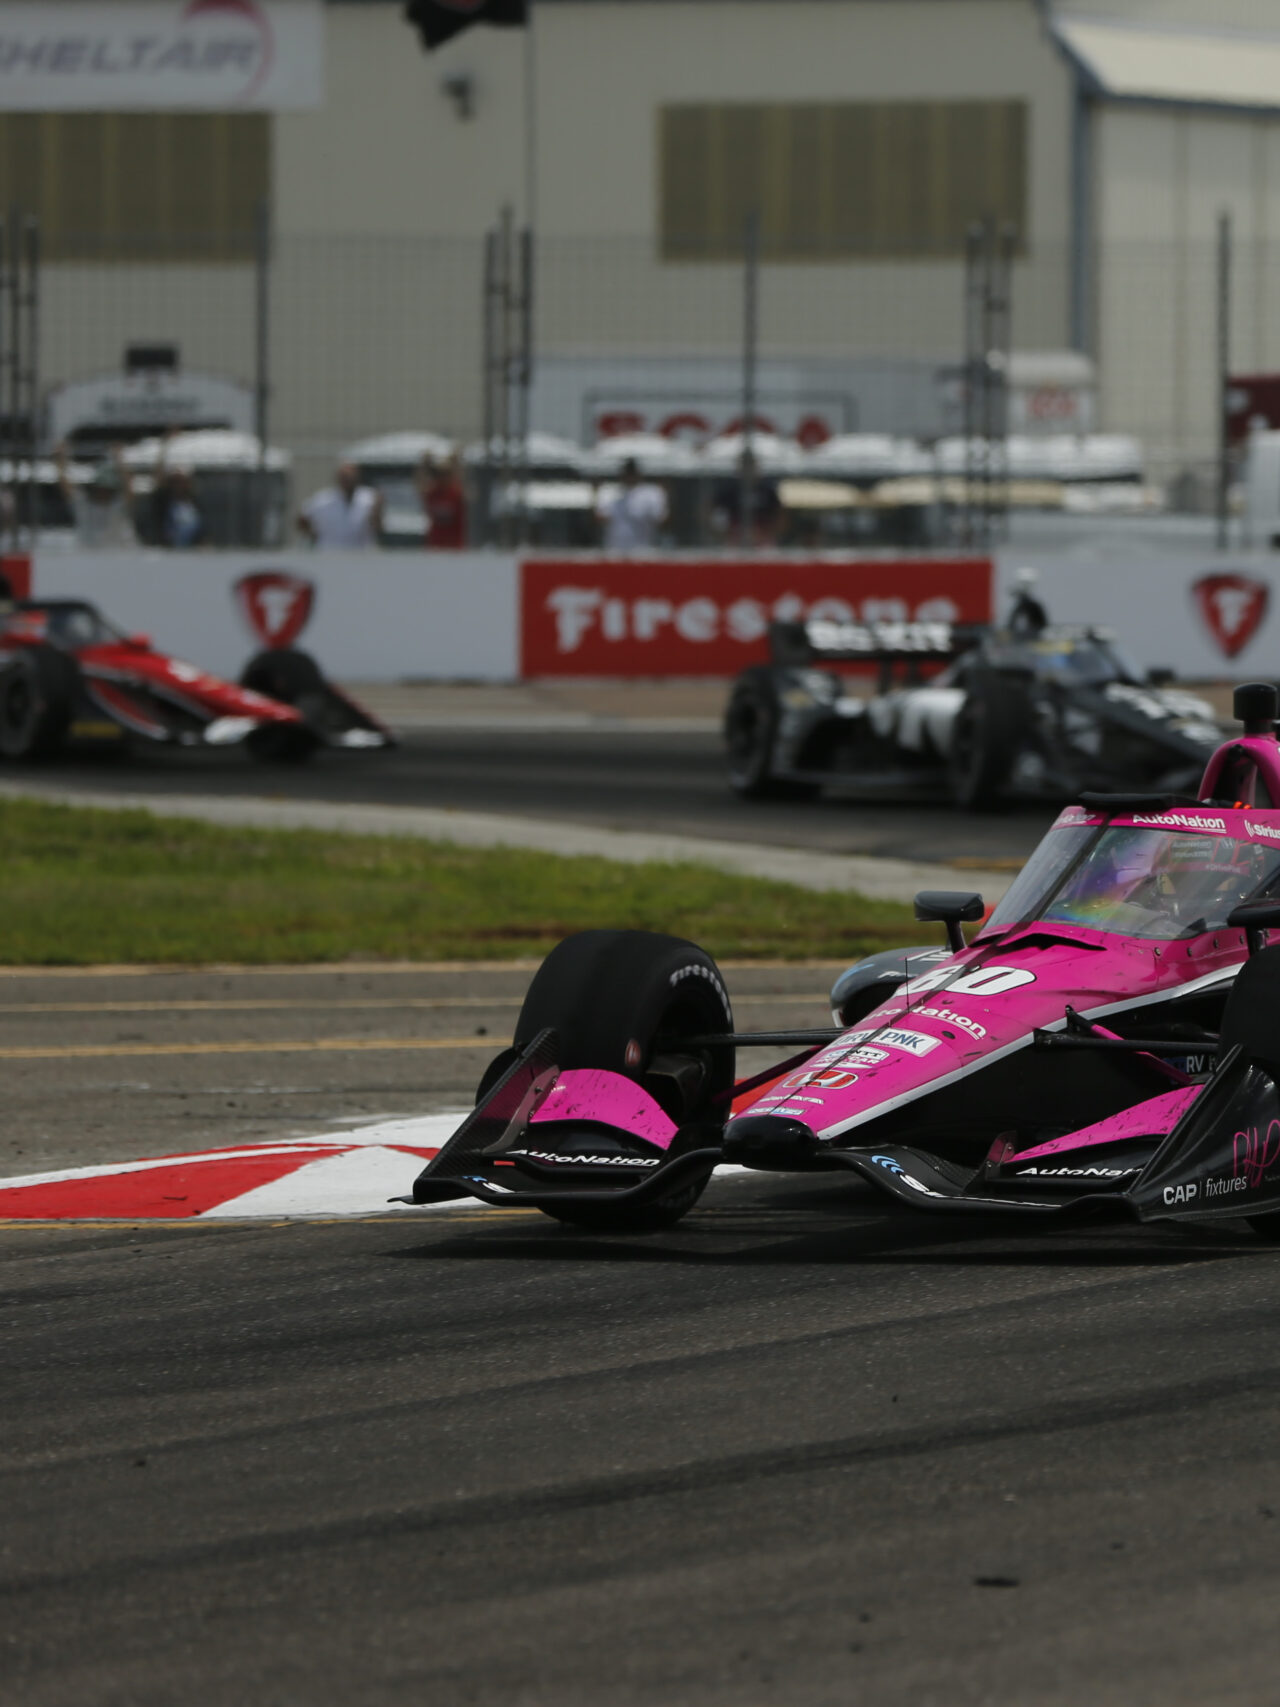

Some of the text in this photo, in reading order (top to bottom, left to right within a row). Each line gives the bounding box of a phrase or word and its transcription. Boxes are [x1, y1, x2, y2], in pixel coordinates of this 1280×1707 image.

[547, 586, 958, 653] Firestone
[1132, 814, 1226, 833] AutoNation
[893, 964, 1037, 997] 60
[868, 1005, 988, 1041] toation
[879, 1030, 926, 1050] PNK
[505, 1149, 659, 1167] AutoNation
[1016, 1166, 1145, 1176] AutoNat
[1163, 1186, 1197, 1206] CAP
[1205, 1175, 1248, 1198] fixtures
